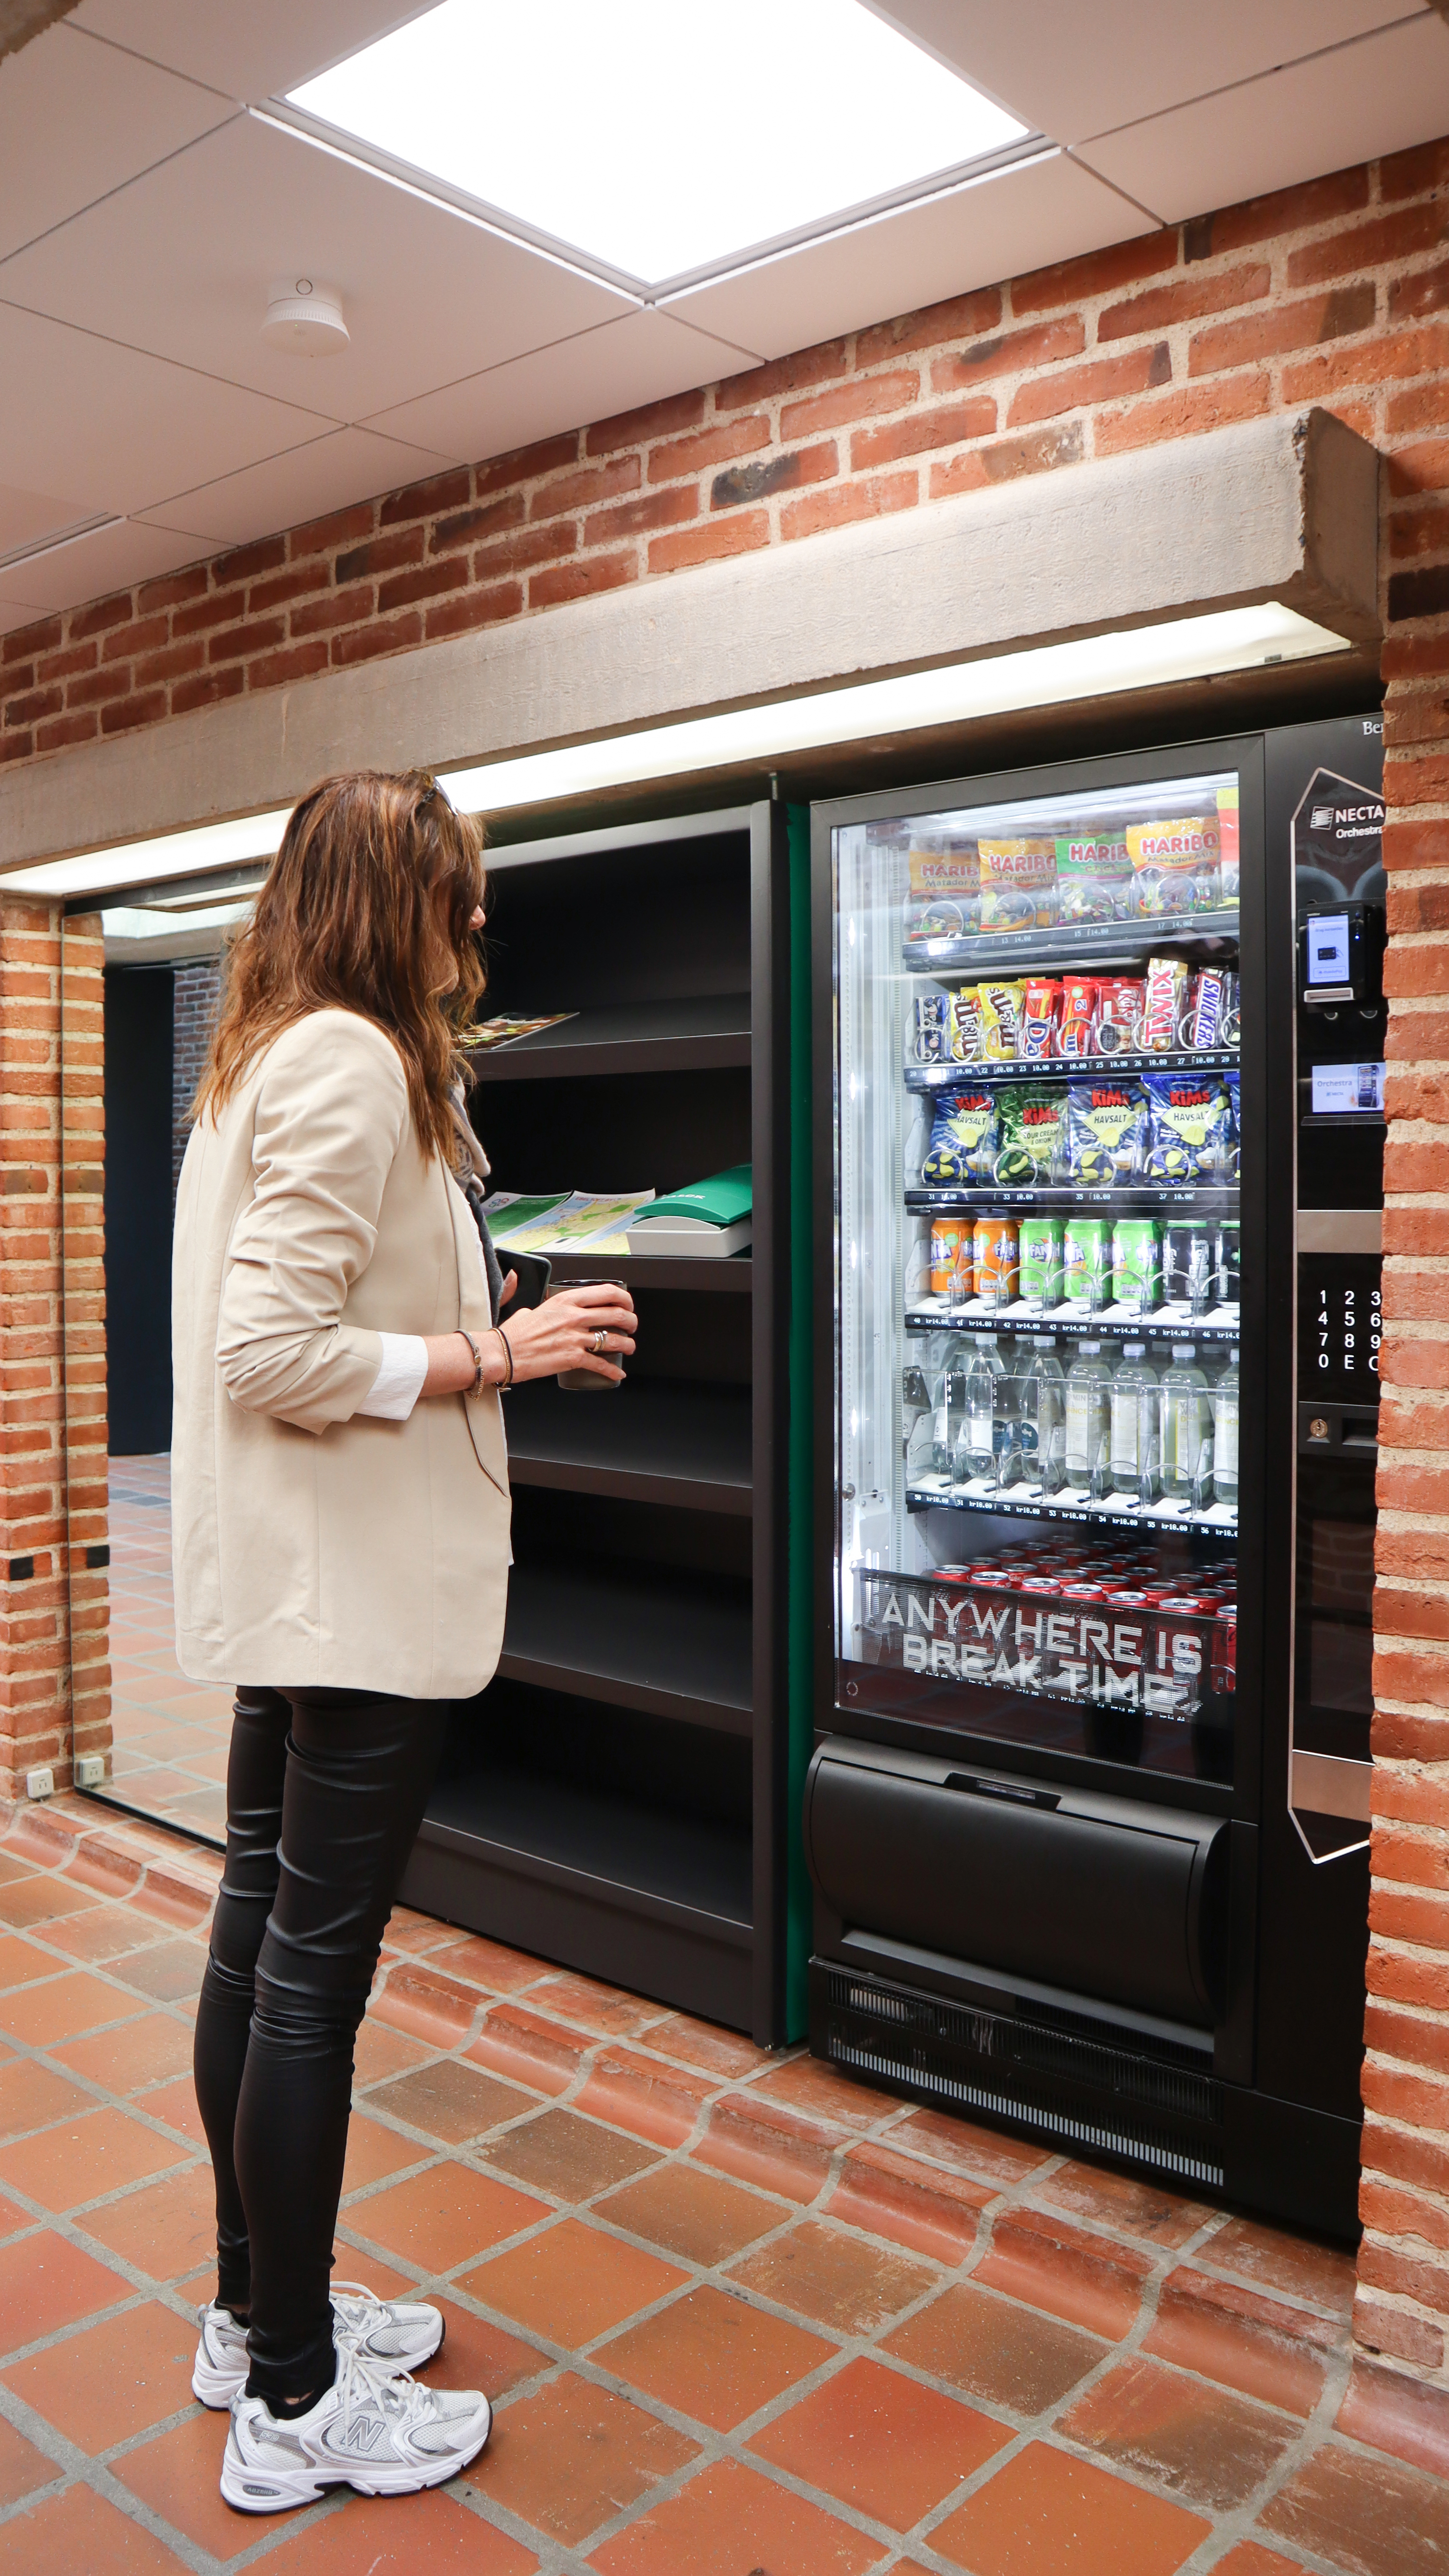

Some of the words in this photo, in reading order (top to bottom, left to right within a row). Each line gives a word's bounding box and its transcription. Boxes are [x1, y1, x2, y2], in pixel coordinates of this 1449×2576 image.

[1336, 805, 1384, 823] NECTA
[1140, 831, 1218, 855] HARIBO
[1069, 843, 1130, 862] HARIB
[921, 864, 980, 877] HARIB
[989, 854, 1056, 873] HARIBO
[1144, 968, 1175, 1047] TWIX
[1195, 979, 1219, 1048] SNICKERS
[955, 1116, 986, 1126] HAVSALT
[1094, 1114, 1127, 1124] HAVSALT
[1040, 1129, 1059, 1137] CREAM
[1320, 1290, 1326, 1304] 1
[1345, 1290, 1355, 1305] 2
[1371, 1291, 1381, 1306] 3
[1318, 1311, 1328, 1325] 4
[1345, 1311, 1355, 1326] 5
[1370, 1312, 1381, 1327] 6
[1217, 1331, 1240, 1339] kr14.0
[1319, 1333, 1328, 1346] 7
[1345, 1334, 1355, 1348] 8
[1371, 1334, 1381, 1349] 9
[1345, 1355, 1354, 1370] E
[1368, 1356, 1379, 1371] C
[1147, 1520, 1156, 1529] 55
[1161, 1522, 1188, 1532] kr18.00
[1201, 1527, 1209, 1535] 56
[1215, 1528, 1238, 1538] kr18.0
[881, 1591, 1142, 1665] ANYWHERE
[1156, 1631, 1202, 1675] IS
[903, 1633, 1043, 1690] BREAK
[1059, 1659, 1177, 1714] TIME
[259, 2430, 280, 2442] 530
[341, 2416, 385, 2452] N
